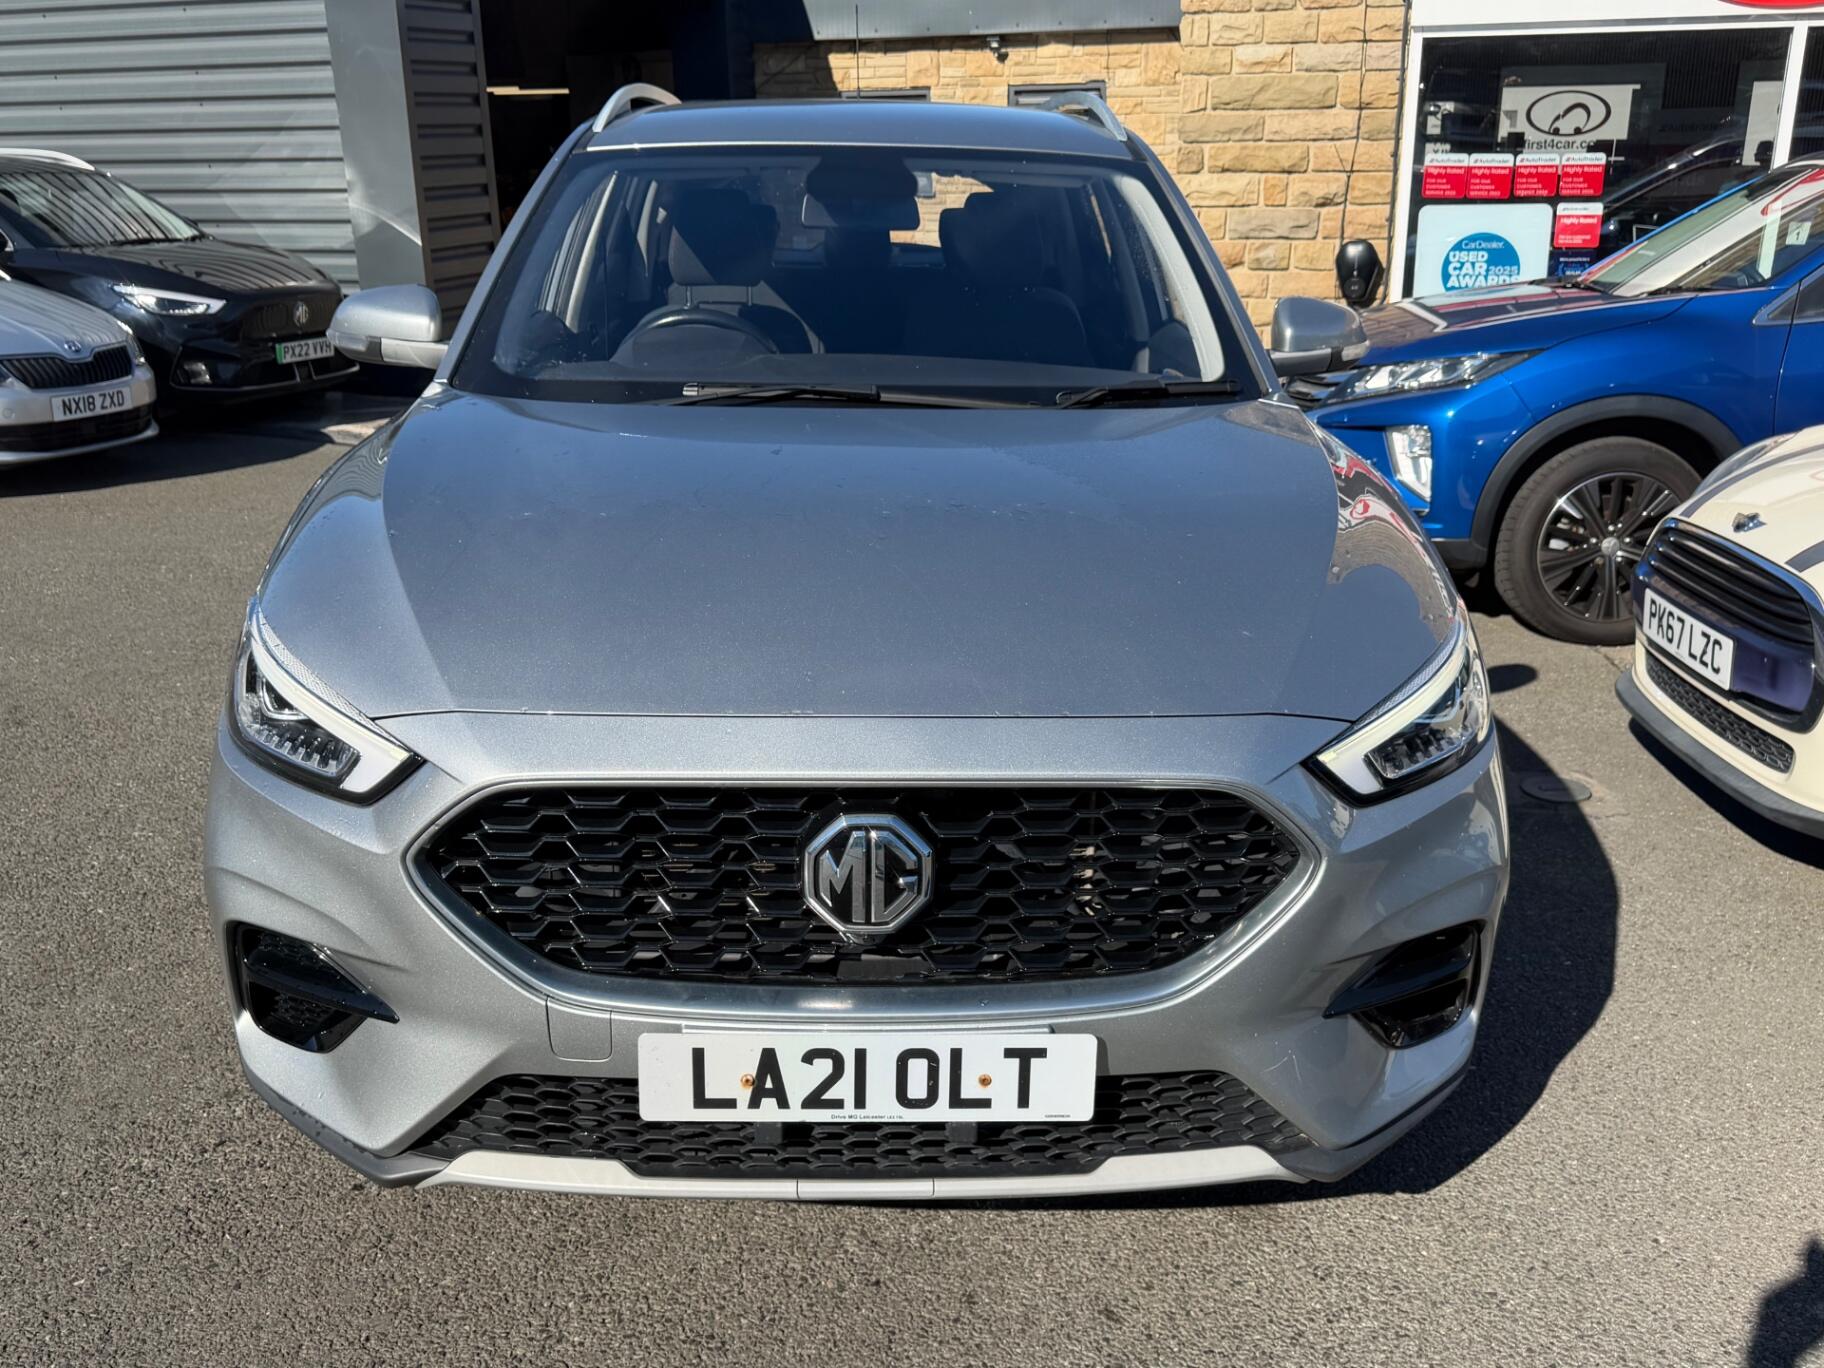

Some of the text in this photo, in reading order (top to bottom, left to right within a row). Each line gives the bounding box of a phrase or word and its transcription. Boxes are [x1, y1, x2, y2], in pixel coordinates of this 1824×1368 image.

[1448, 262, 1519, 276] CAR 2025
[1449, 250, 1488, 262] USED
[283, 343, 311, 361] PX22
[62, 389, 126, 417] NX18 ZXD
[1649, 598, 1723, 676] PK67 LZC
[819, 830, 919, 923] MG
[691, 1047, 1048, 1110] LA21 OLT
